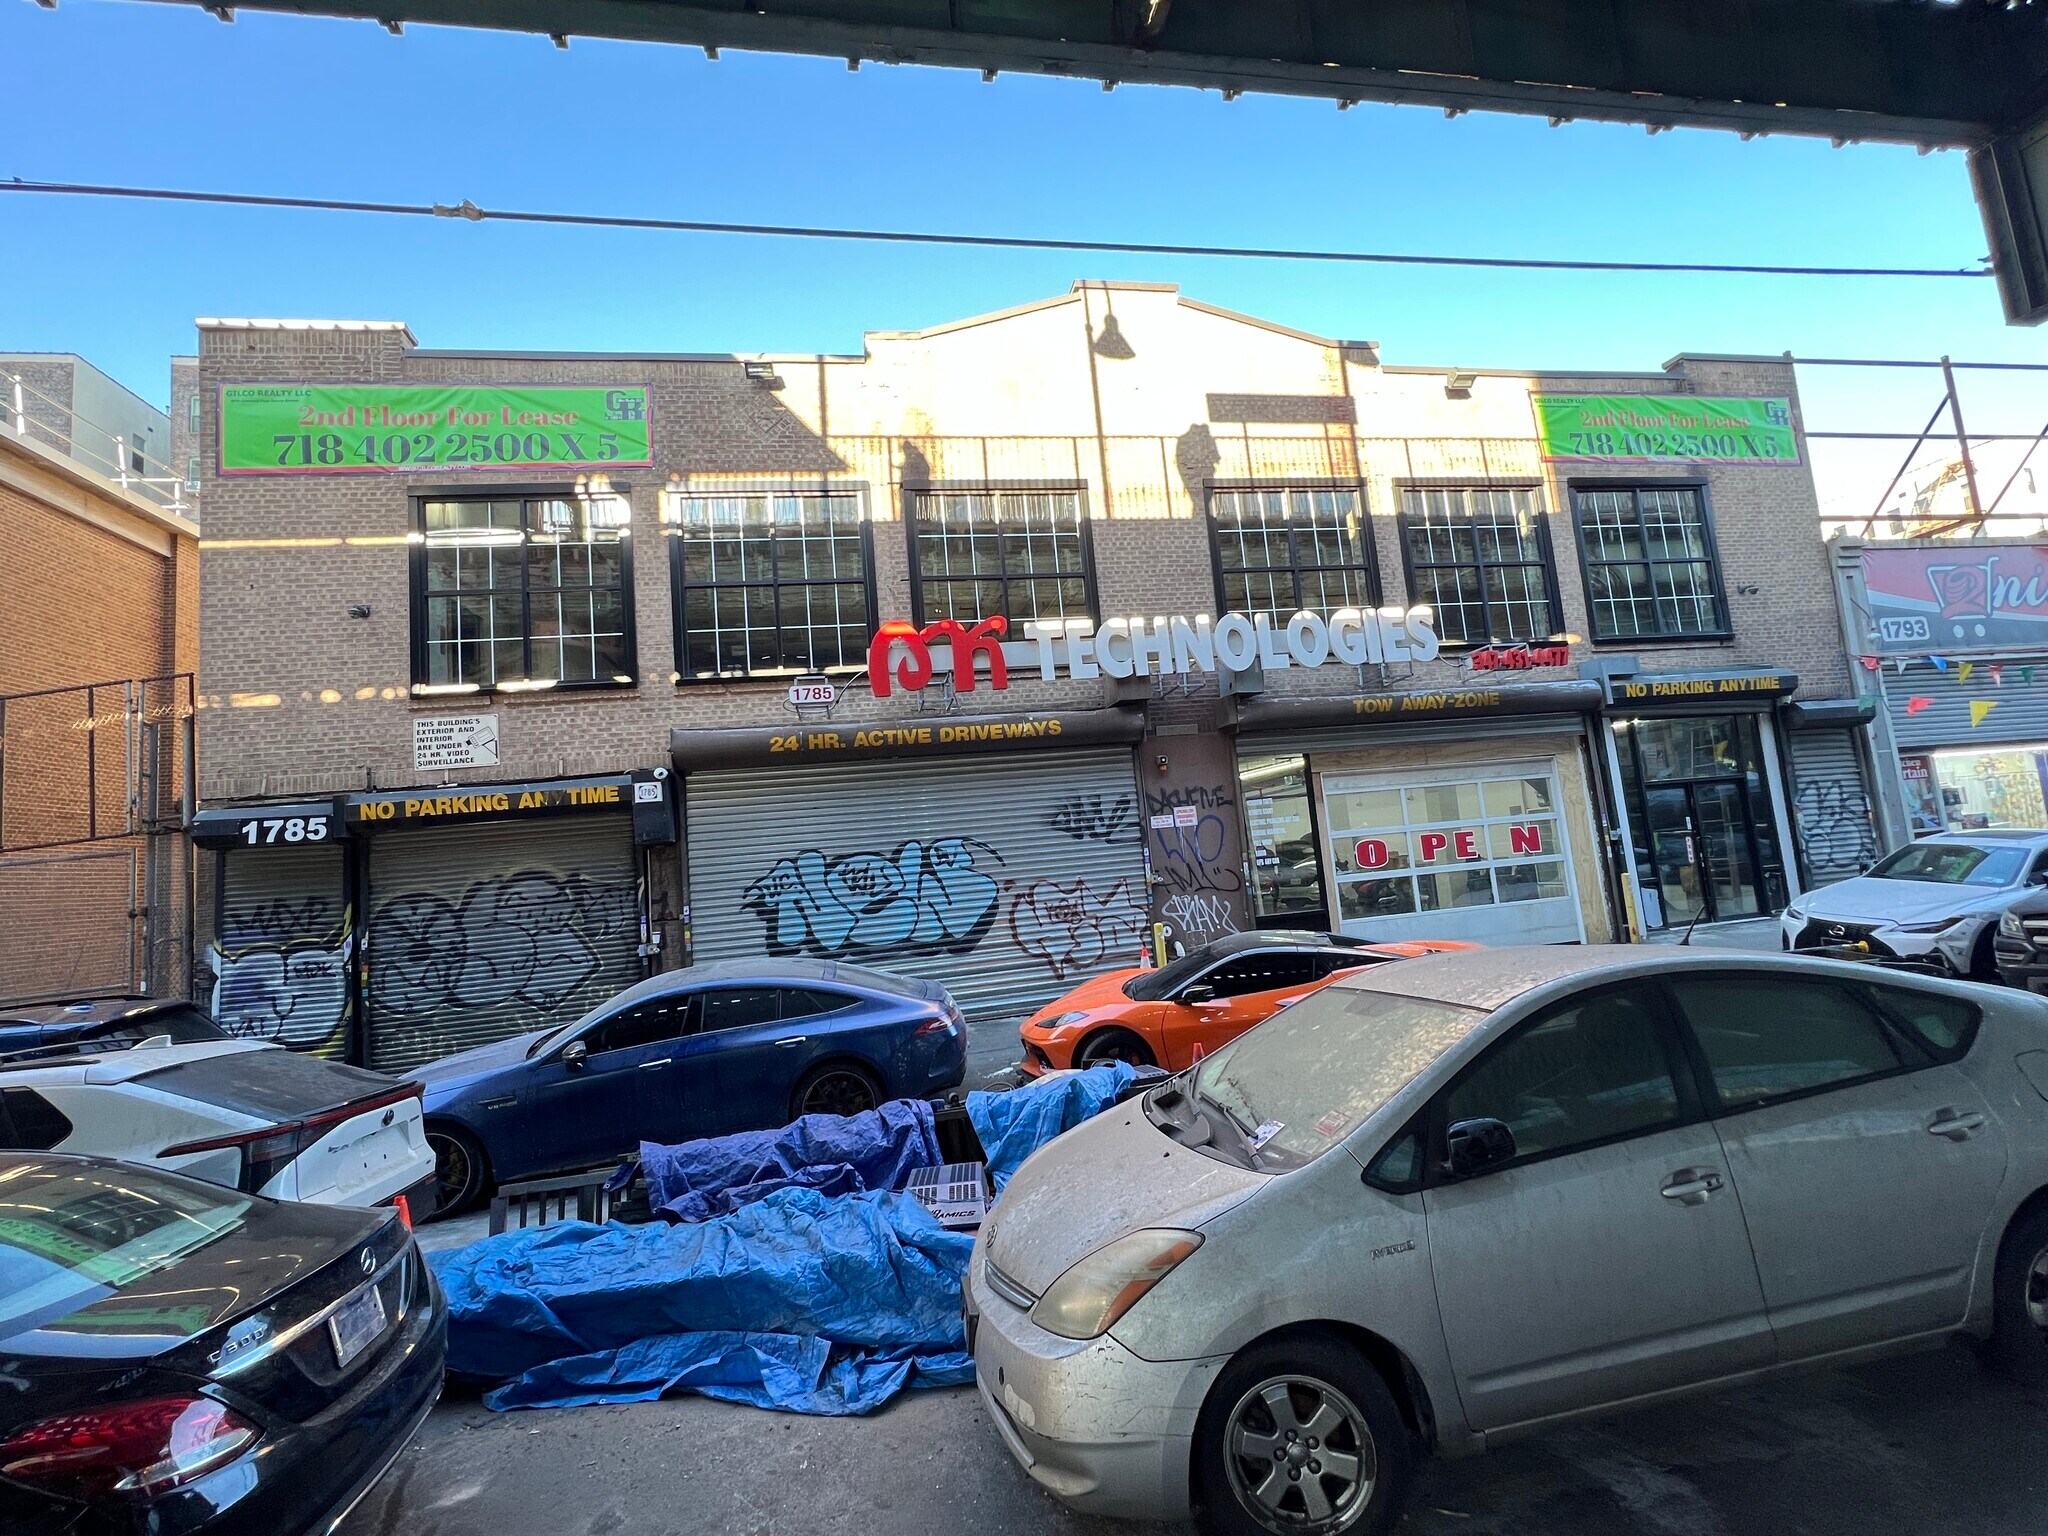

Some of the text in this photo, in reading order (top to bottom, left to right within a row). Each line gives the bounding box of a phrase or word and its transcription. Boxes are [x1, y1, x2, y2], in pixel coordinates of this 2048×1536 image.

[226, 389, 312, 397] GILCO REALTY LLC
[298, 404, 579, 428] 2nd Floor For Lease
[1580, 409, 1751, 429] 2nd Floor For Lease
[273, 432, 619, 465] 718 402 2500 X 5
[1569, 432, 1778, 457] 718 402 2500 X 5
[1882, 619, 1928, 639] 1793
[1023, 605, 1439, 682] TECHNOLOGIES
[792, 687, 832, 701] 1785
[1625, 676, 1780, 698] NO PARKING ANYTIME
[1353, 698, 1394, 714] TOW
[416, 718, 480, 728] THIS BUILDING'S
[416, 727, 455, 735] EXTERIOR
[416, 735, 453, 744] INTERIOR
[769, 719, 1062, 753] 24 HR. ACTIVE DRIVEWAYS
[436, 742, 462, 750] UNDER
[447, 749, 470, 757] VIDEO
[417, 757, 475, 767] SURVEILLANCE
[1902, 766, 1929, 779] rtain
[641, 788, 656, 797] 1785
[359, 801, 396, 821] NO
[405, 792, 509, 818] PARKING
[242, 816, 328, 845] 1785
